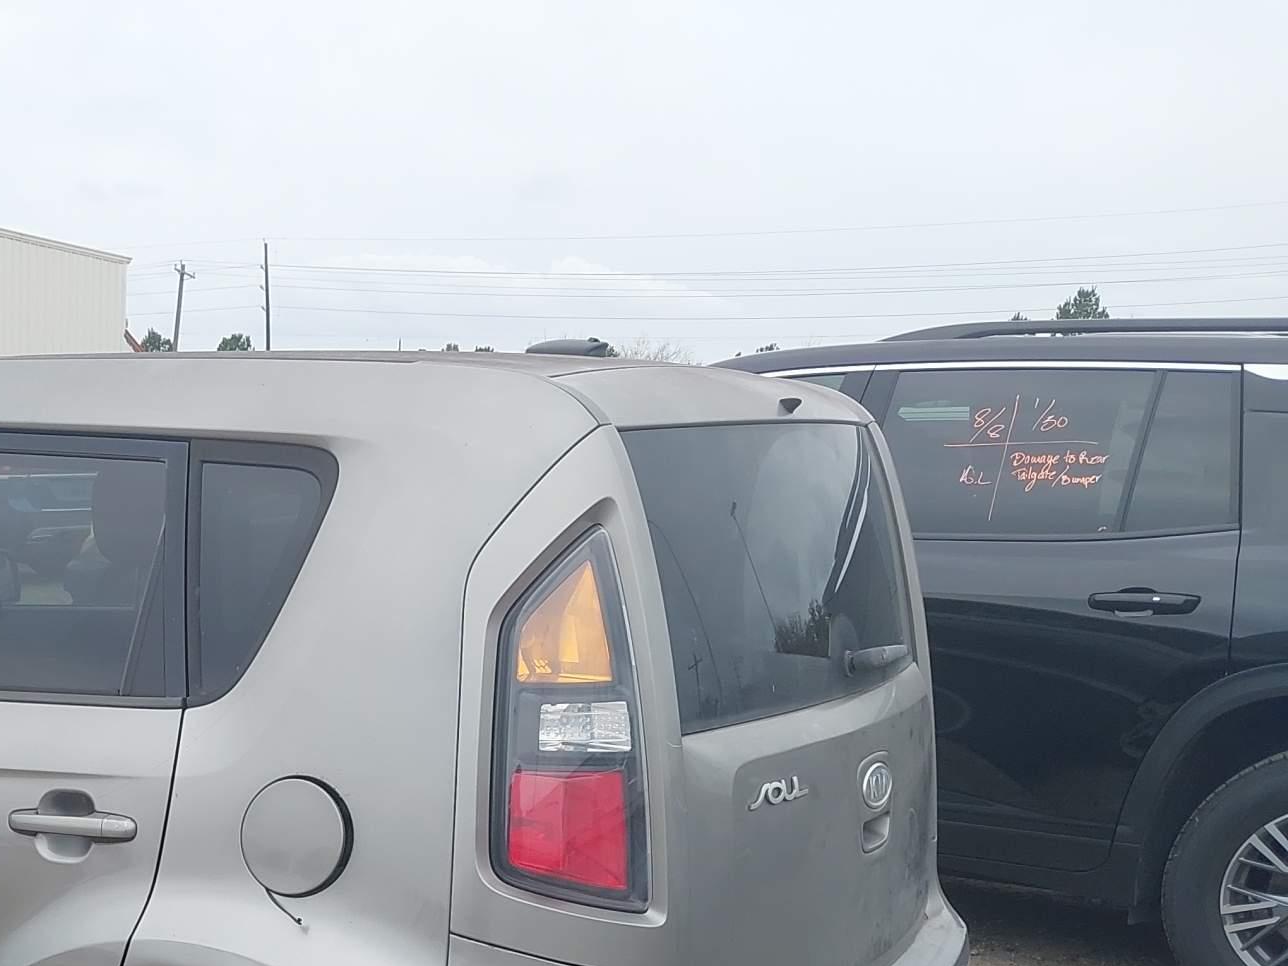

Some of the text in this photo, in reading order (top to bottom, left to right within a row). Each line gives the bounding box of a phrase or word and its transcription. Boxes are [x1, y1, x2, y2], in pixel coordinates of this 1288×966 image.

[1010, 450, 1111, 473] Damage to Rear
